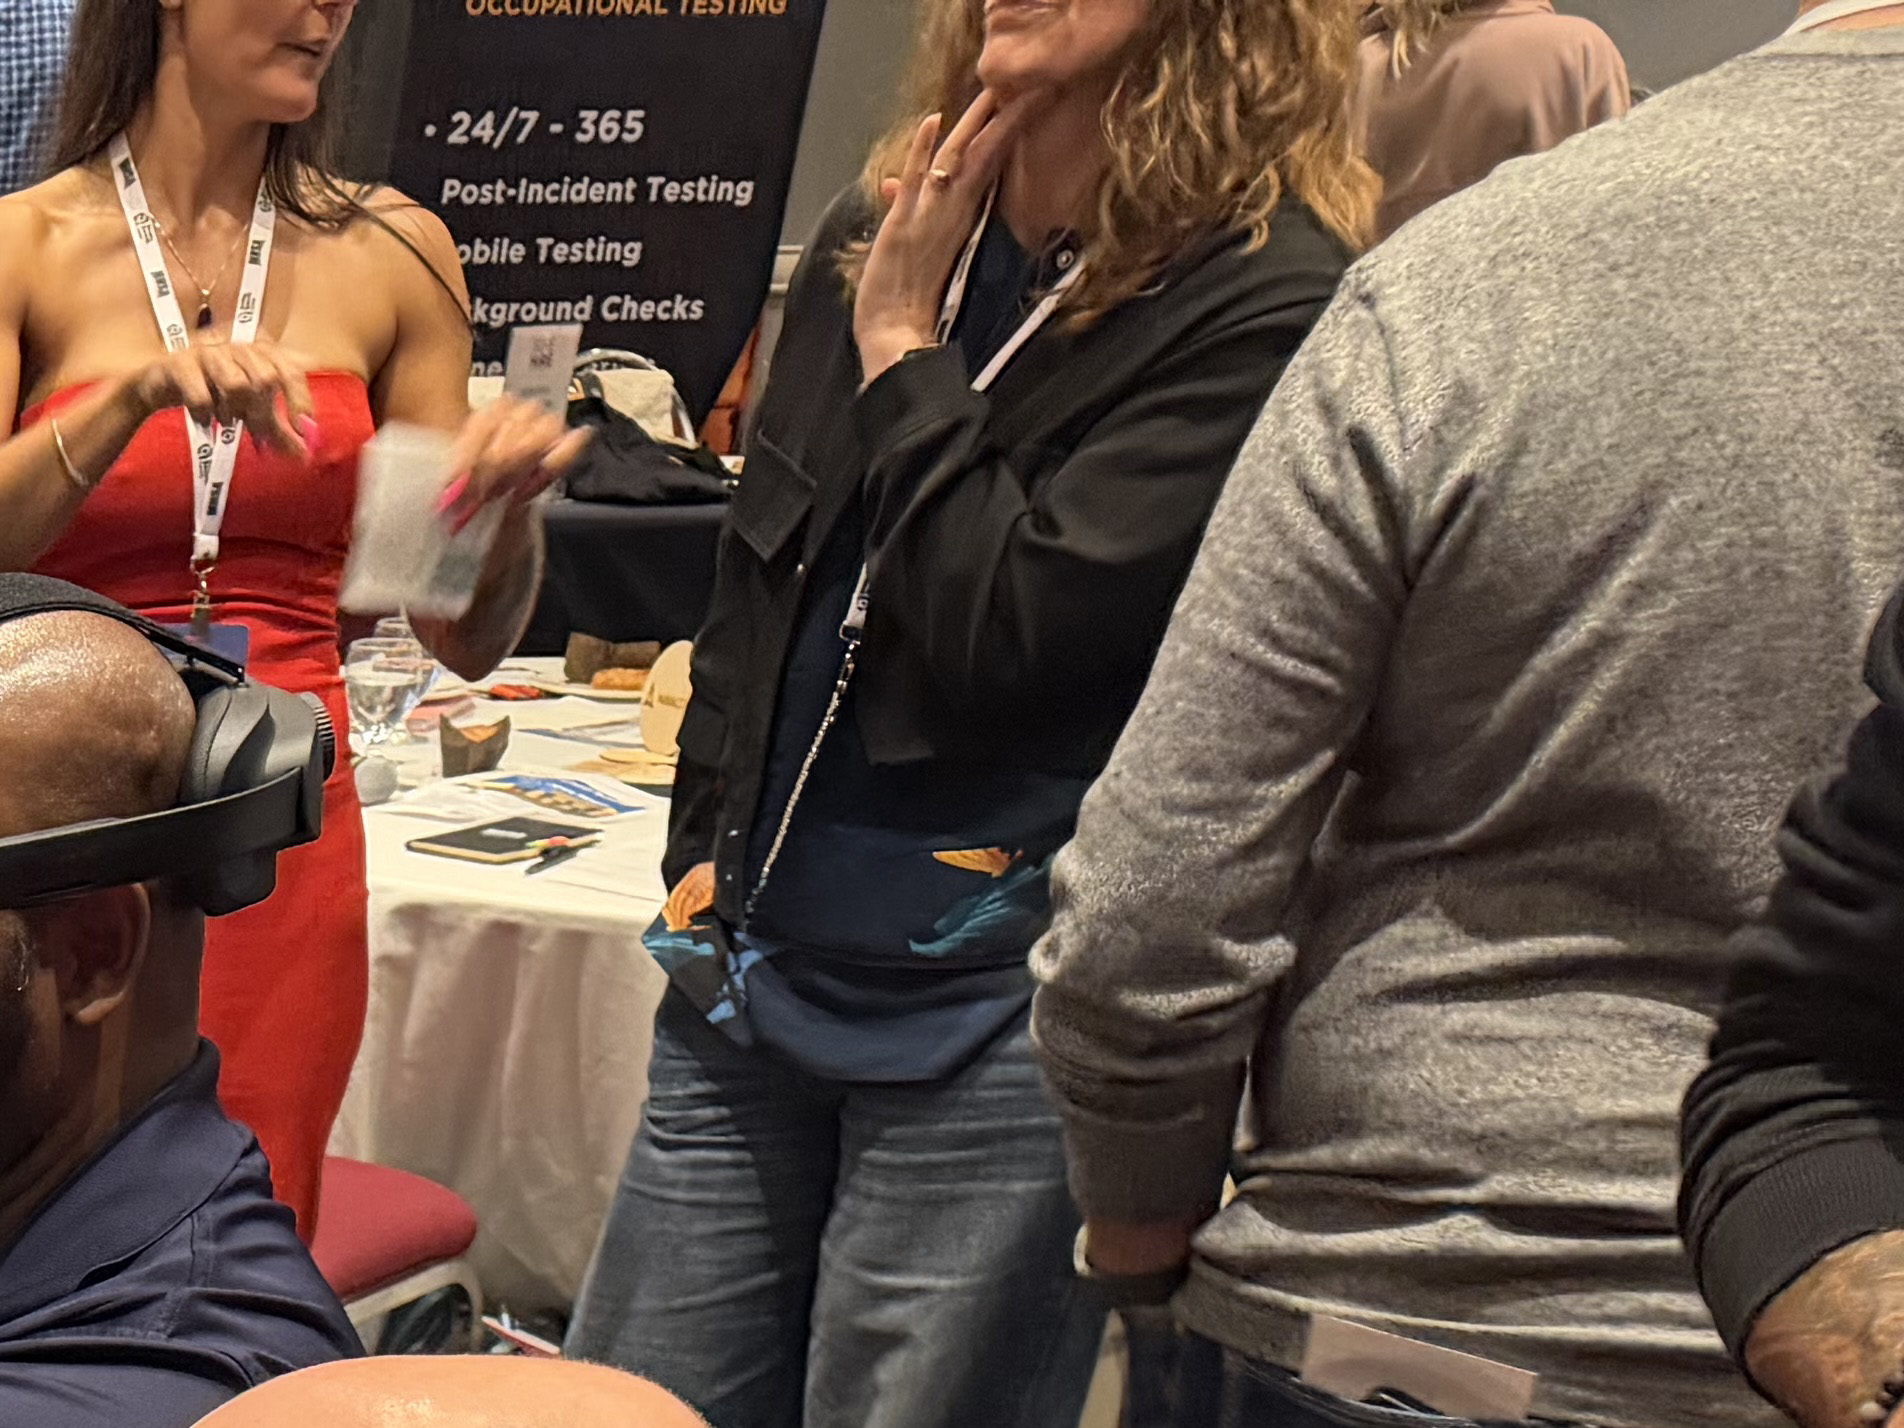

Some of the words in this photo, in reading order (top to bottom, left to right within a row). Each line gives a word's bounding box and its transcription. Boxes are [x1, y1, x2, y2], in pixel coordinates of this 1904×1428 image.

[446, 105, 540, 150] 24/7
[575, 109, 646, 144] 365
[441, 176, 637, 207] Post-Incident
[646, 174, 755, 207] Testing
[457, 237, 526, 266] obile
[535, 235, 643, 267] Testing
[473, 296, 594, 329] kground
[601, 294, 706, 323] Checks
